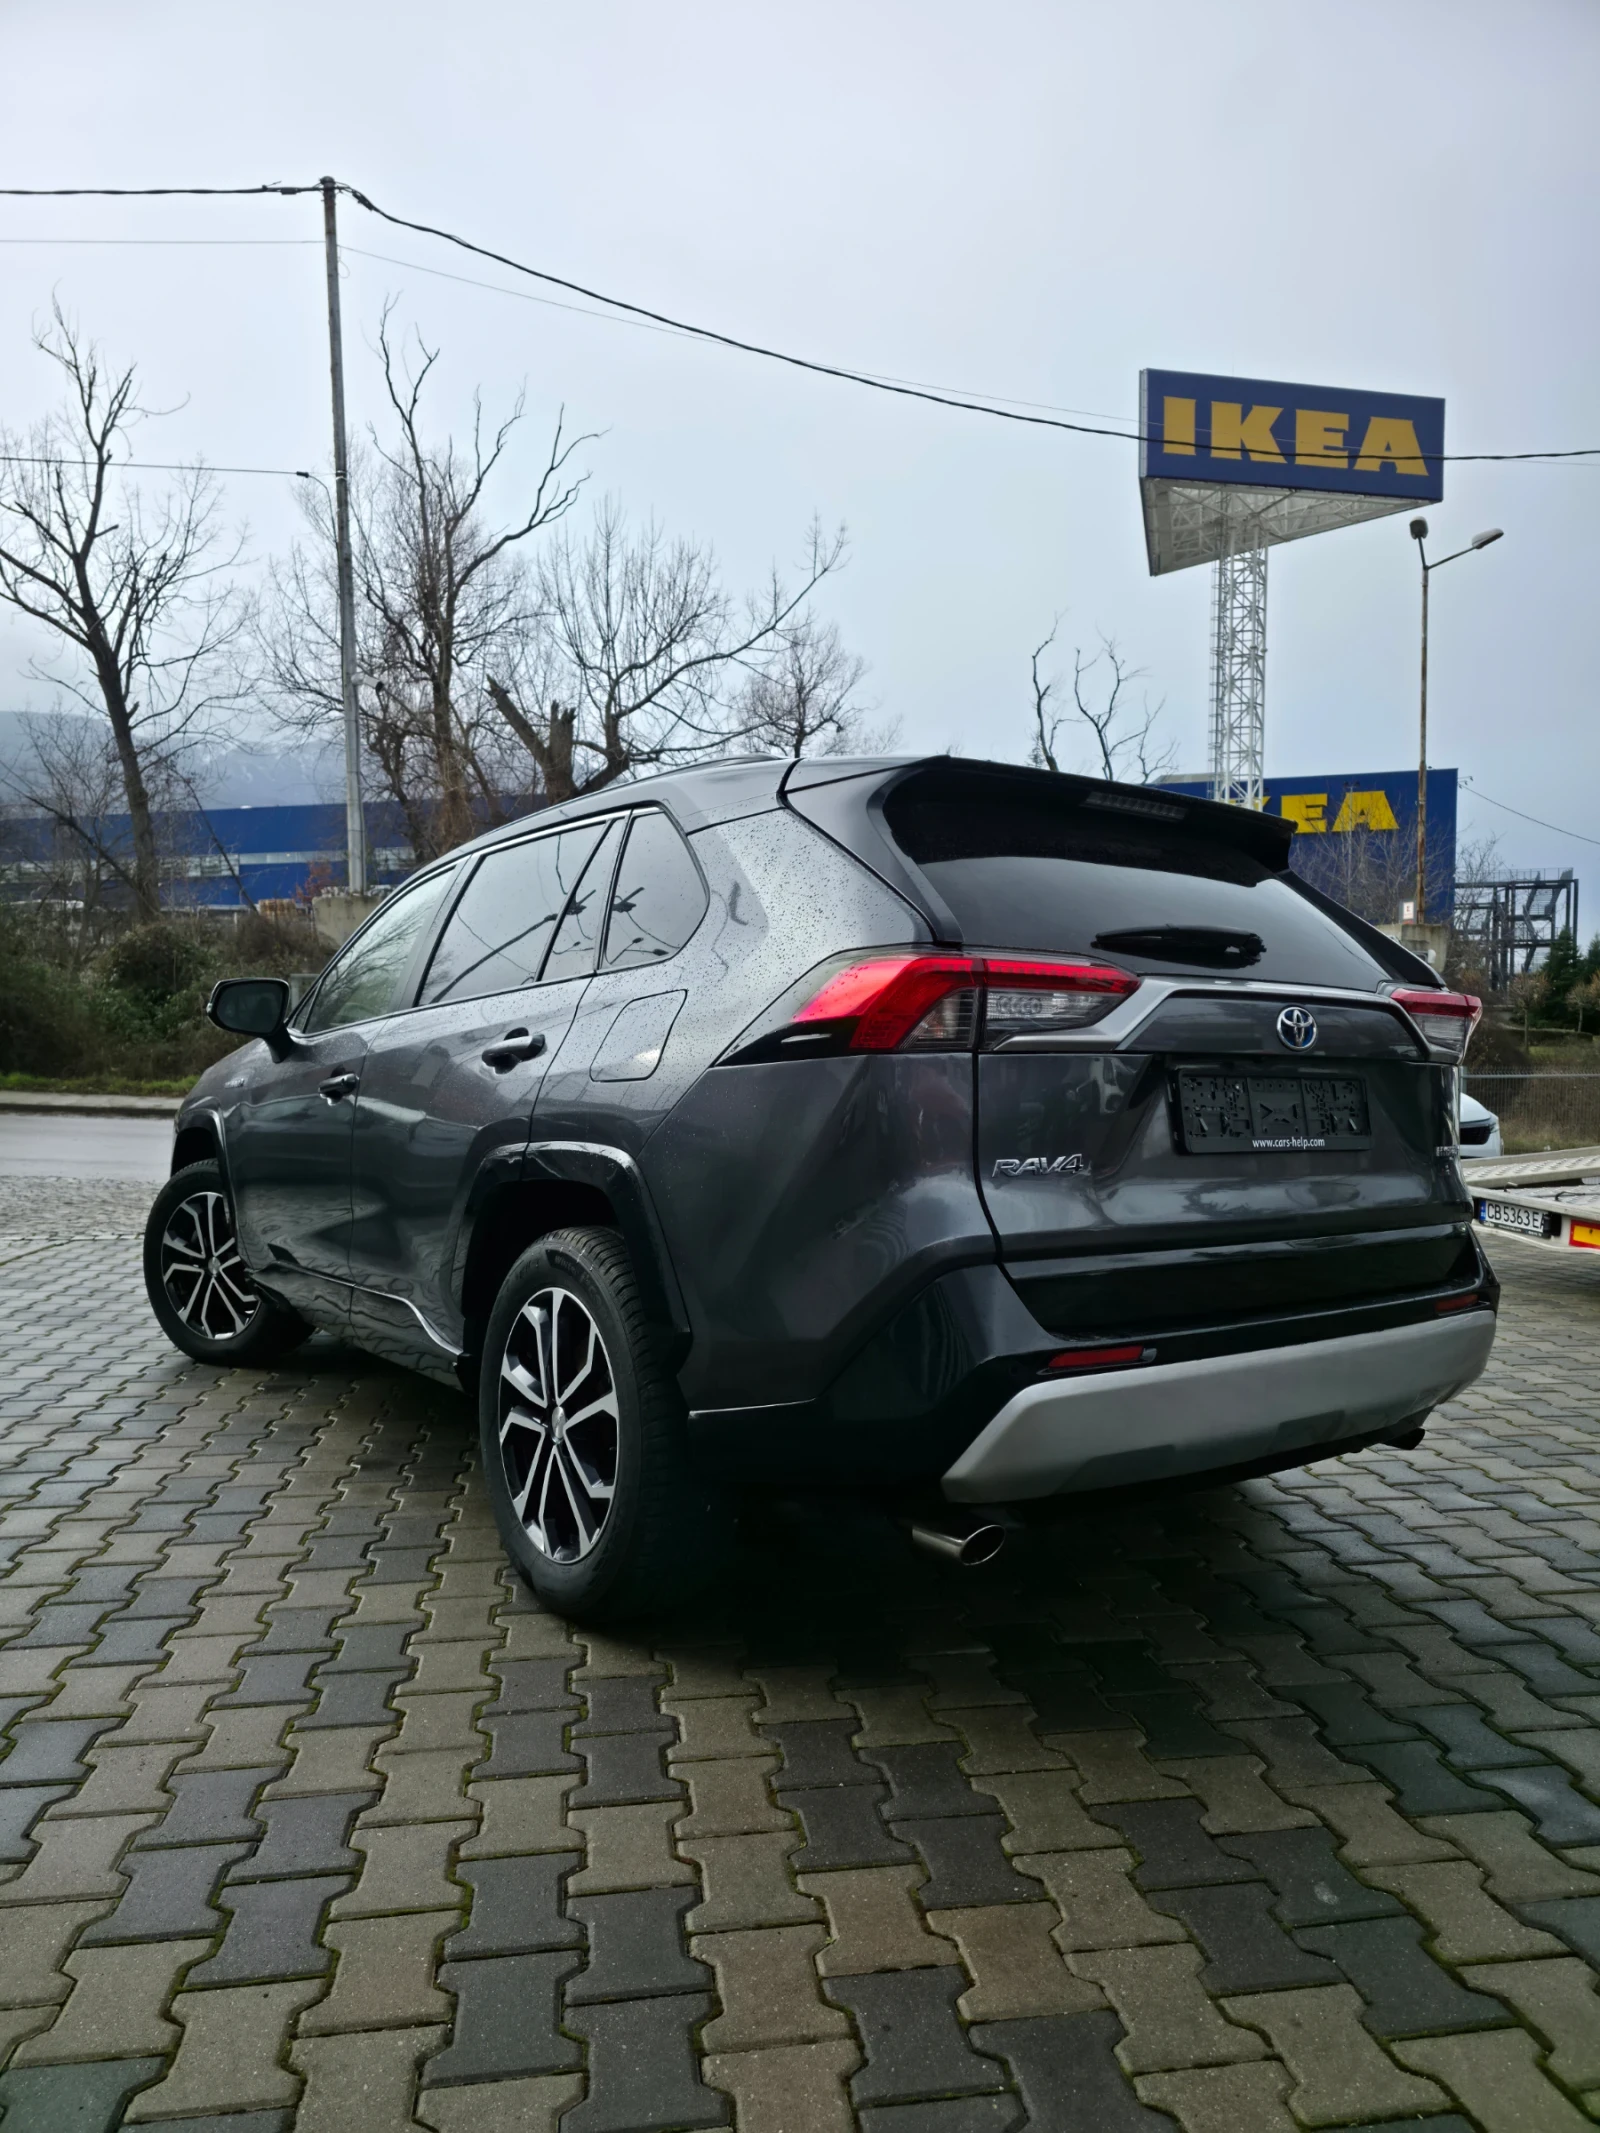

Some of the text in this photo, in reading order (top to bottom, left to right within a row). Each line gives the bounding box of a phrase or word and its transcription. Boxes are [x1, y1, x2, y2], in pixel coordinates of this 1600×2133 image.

[1163, 396, 1429, 476] IKEA
[1229, 791, 1400, 834] EA
[1252, 1136, 1325, 1150] www.cars-help.com
[991, 1153, 1084, 1178] RAV4
[1487, 1203, 1502, 1220] CB
[1503, 1206, 1530, 1226] 5363
